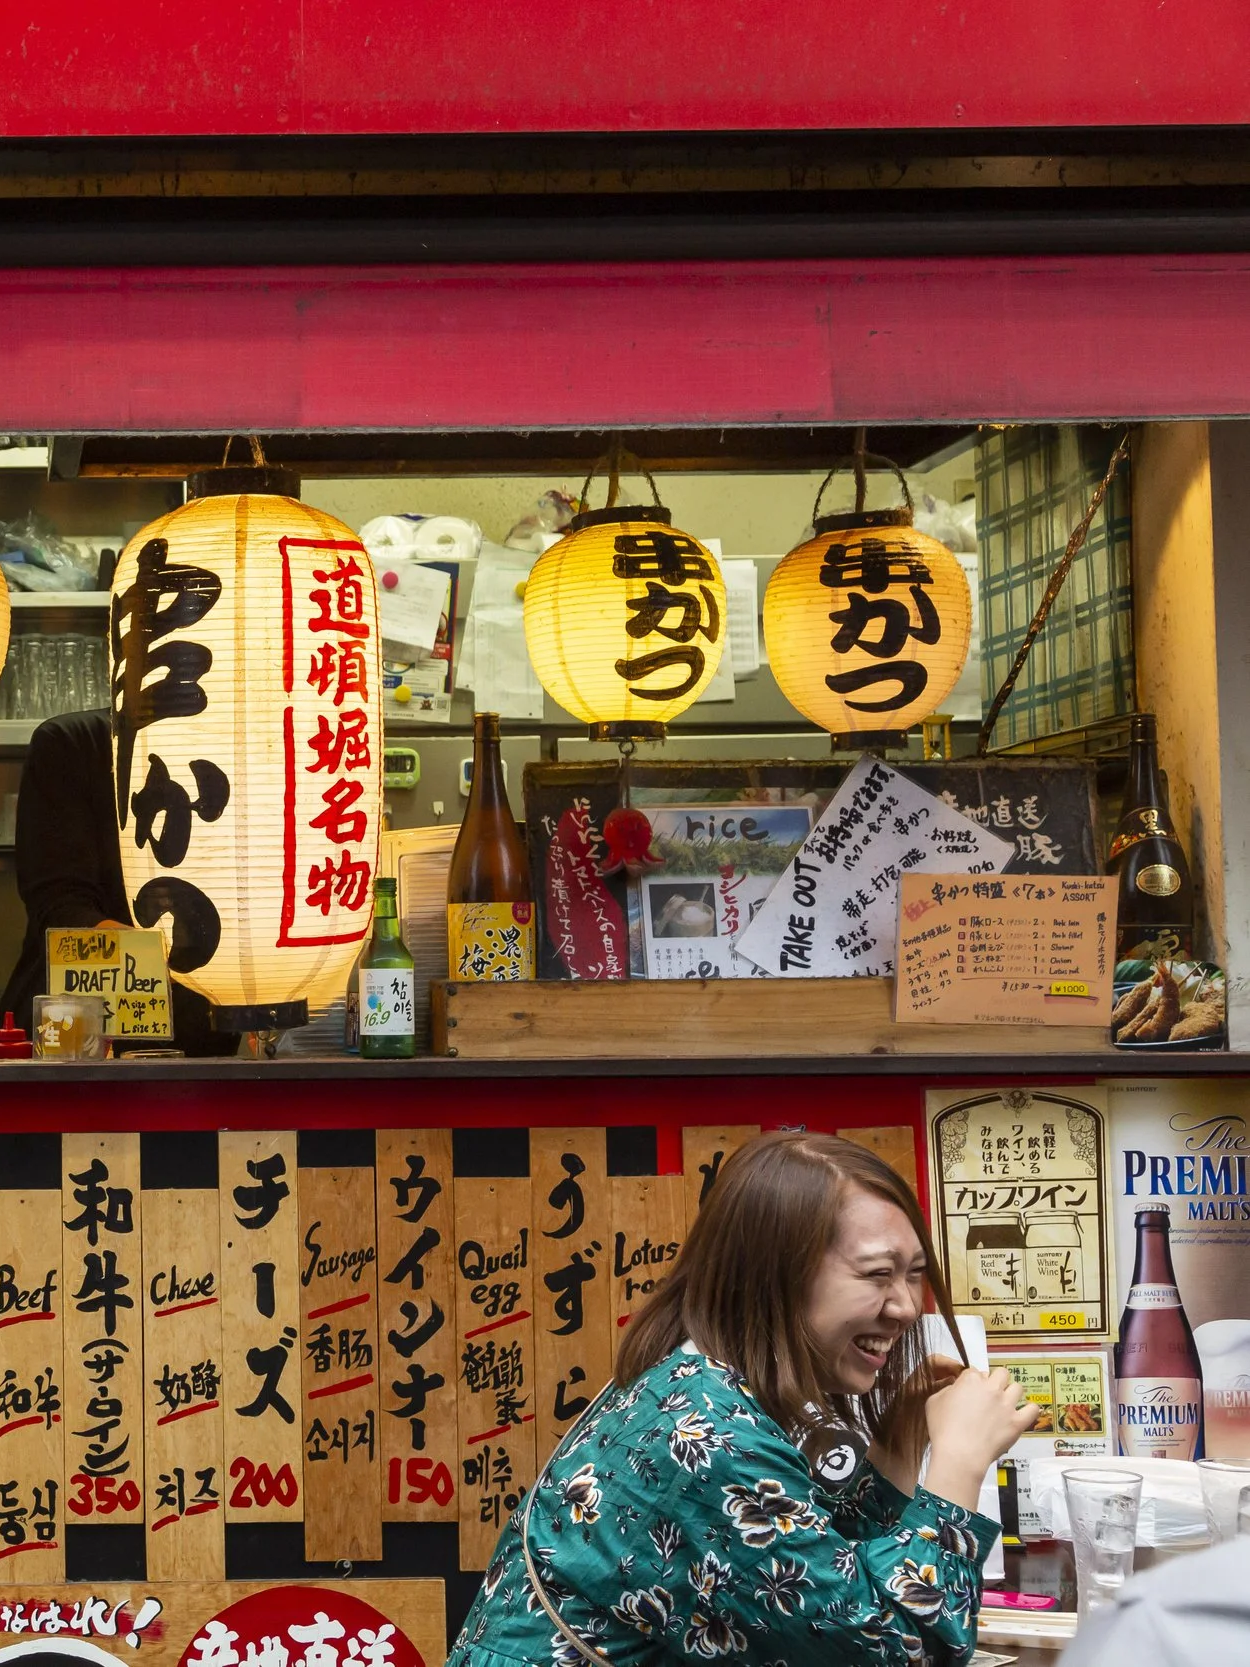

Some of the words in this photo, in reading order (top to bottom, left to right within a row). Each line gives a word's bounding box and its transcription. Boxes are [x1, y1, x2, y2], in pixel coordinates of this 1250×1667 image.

[612, 531, 721, 701] 串かつ
[820, 537, 941, 714] 串かつ
[111, 537, 231, 975] 串かつ
[305, 555, 372, 918] 道頓堀名物
[686, 815, 770, 842] rice
[1016, 832, 1067, 865] 豚
[718, 864, 747, 936] コシヒカリ
[793, 856, 822, 908] OUT
[931, 881, 1006, 905] 串かつ特盛
[1062, 892, 1097, 902] ASSORT
[56, 933, 116, 963] 生ビール
[458, 943, 492, 979] 梅
[780, 914, 815, 972] TAKE
[65, 968, 120, 992] DRAFT
[125, 952, 162, 993] Beer
[1055, 984, 1085, 993] ¥1000
[118, 998, 130, 1010] M
[131, 1000, 146, 1009] size
[133, 1007, 146, 1020] or
[364, 1010, 391, 1028] 16.9
[390, 977, 413, 1022] 참이슬
[43, 1026, 61, 1047] 生
[121, 1022, 131, 1035] L
[132, 1023, 149, 1034] size
[981, 1125, 994, 1175] みなはれ
[1042, 1123, 1056, 1160] 気軽に
[1169, 1112, 1250, 1151] The
[996, 1137, 1010, 1175] 飲んで
[1027, 1136, 1041, 1174] 飲める
[1122, 1150, 1250, 1196] PREMI
[955, 1184, 1087, 1210] カップワイン
[302, 1220, 377, 1289] Sausage
[458, 1228, 530, 1281] Quail
[613, 1232, 682, 1278] Lotus
[981, 1260, 995, 1268] Red
[981, 1268, 1003, 1277] Wine
[1037, 1258, 1059, 1267] White
[1037, 1267, 1059, 1276] Wine
[150, 1266, 217, 1306] Chese
[232, 1152, 298, 1425] チーズ
[383, 1154, 446, 1451] ウインナー
[470, 1279, 523, 1319] egg
[542, 1151, 604, 1424] うずら
[63, 1157, 136, 1478] 和牛(サーロイン)
[1049, 1314, 1077, 1326] 450
[1087, 1317, 1098, 1328] 円
[303, 1322, 374, 1374] 香肠
[154, 1358, 222, 1414] 奶酪
[1066, 1393, 1100, 1403] ¥1,200
[1134, 1385, 1179, 1403] The
[494, 1388, 531, 1426] 蛋
[1118, 1403, 1198, 1425] PREMIUM
[305, 1408, 376, 1465] 소시지
[1143, 1425, 1174, 1437] MALT'S
[228, 1455, 299, 1509] 200
[387, 1456, 455, 1508] 150
[462, 1445, 513, 1490] 메추
[67, 1474, 142, 1517] 350
[156, 1466, 220, 1517] 치즈
